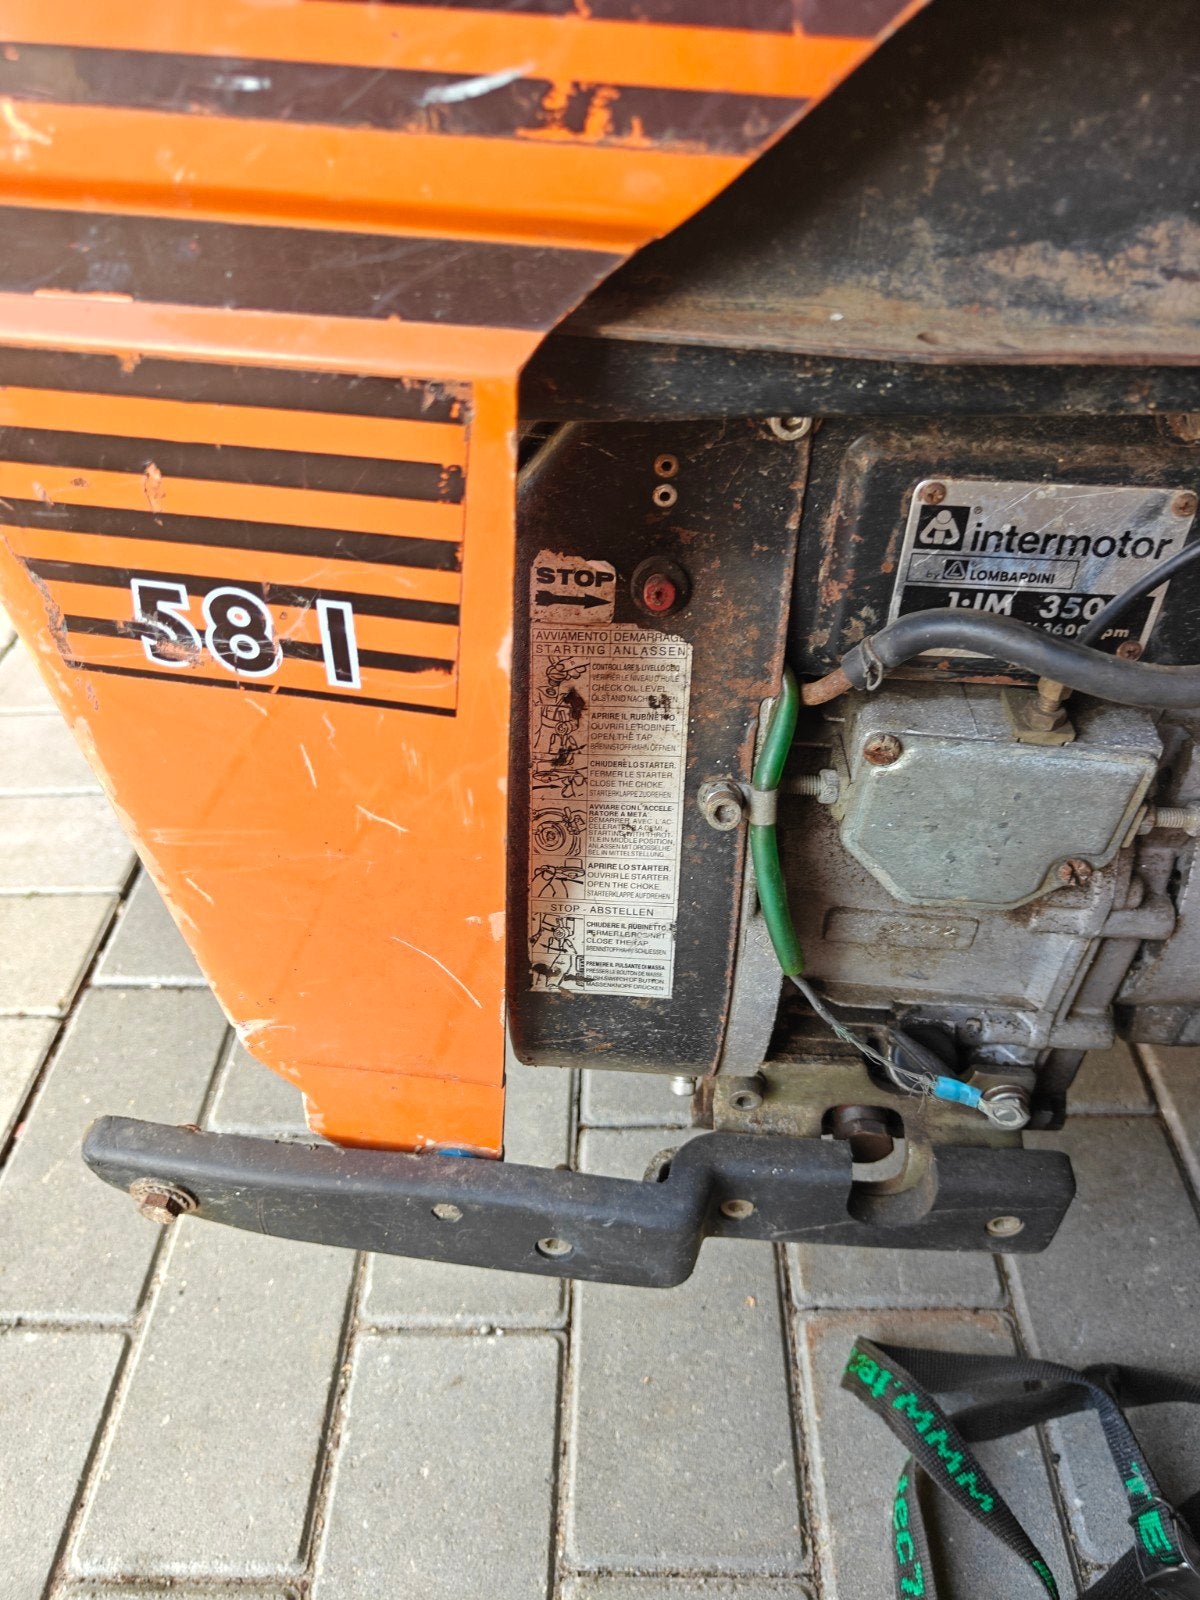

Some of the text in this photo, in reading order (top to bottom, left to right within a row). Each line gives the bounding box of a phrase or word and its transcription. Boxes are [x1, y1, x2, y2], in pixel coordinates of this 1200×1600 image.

[970, 522, 1173, 560] intermotor
[536, 567, 615, 588] STOP
[970, 570, 1056, 584] LOMBARDINI
[535, 631, 608, 642] AVVIAMENTO
[1101, 628, 1130, 640] pm
[536, 644, 686, 656] STARTING ANLASSEN
[592, 684, 622, 692] CHECK
[624, 684, 637, 692] OIL
[590, 760, 628, 768] CHIUDERE
[551, 904, 580, 912] STOP
[590, 906, 654, 916] ABSTELLEN
[586, 921, 620, 929] CHIUDERE
